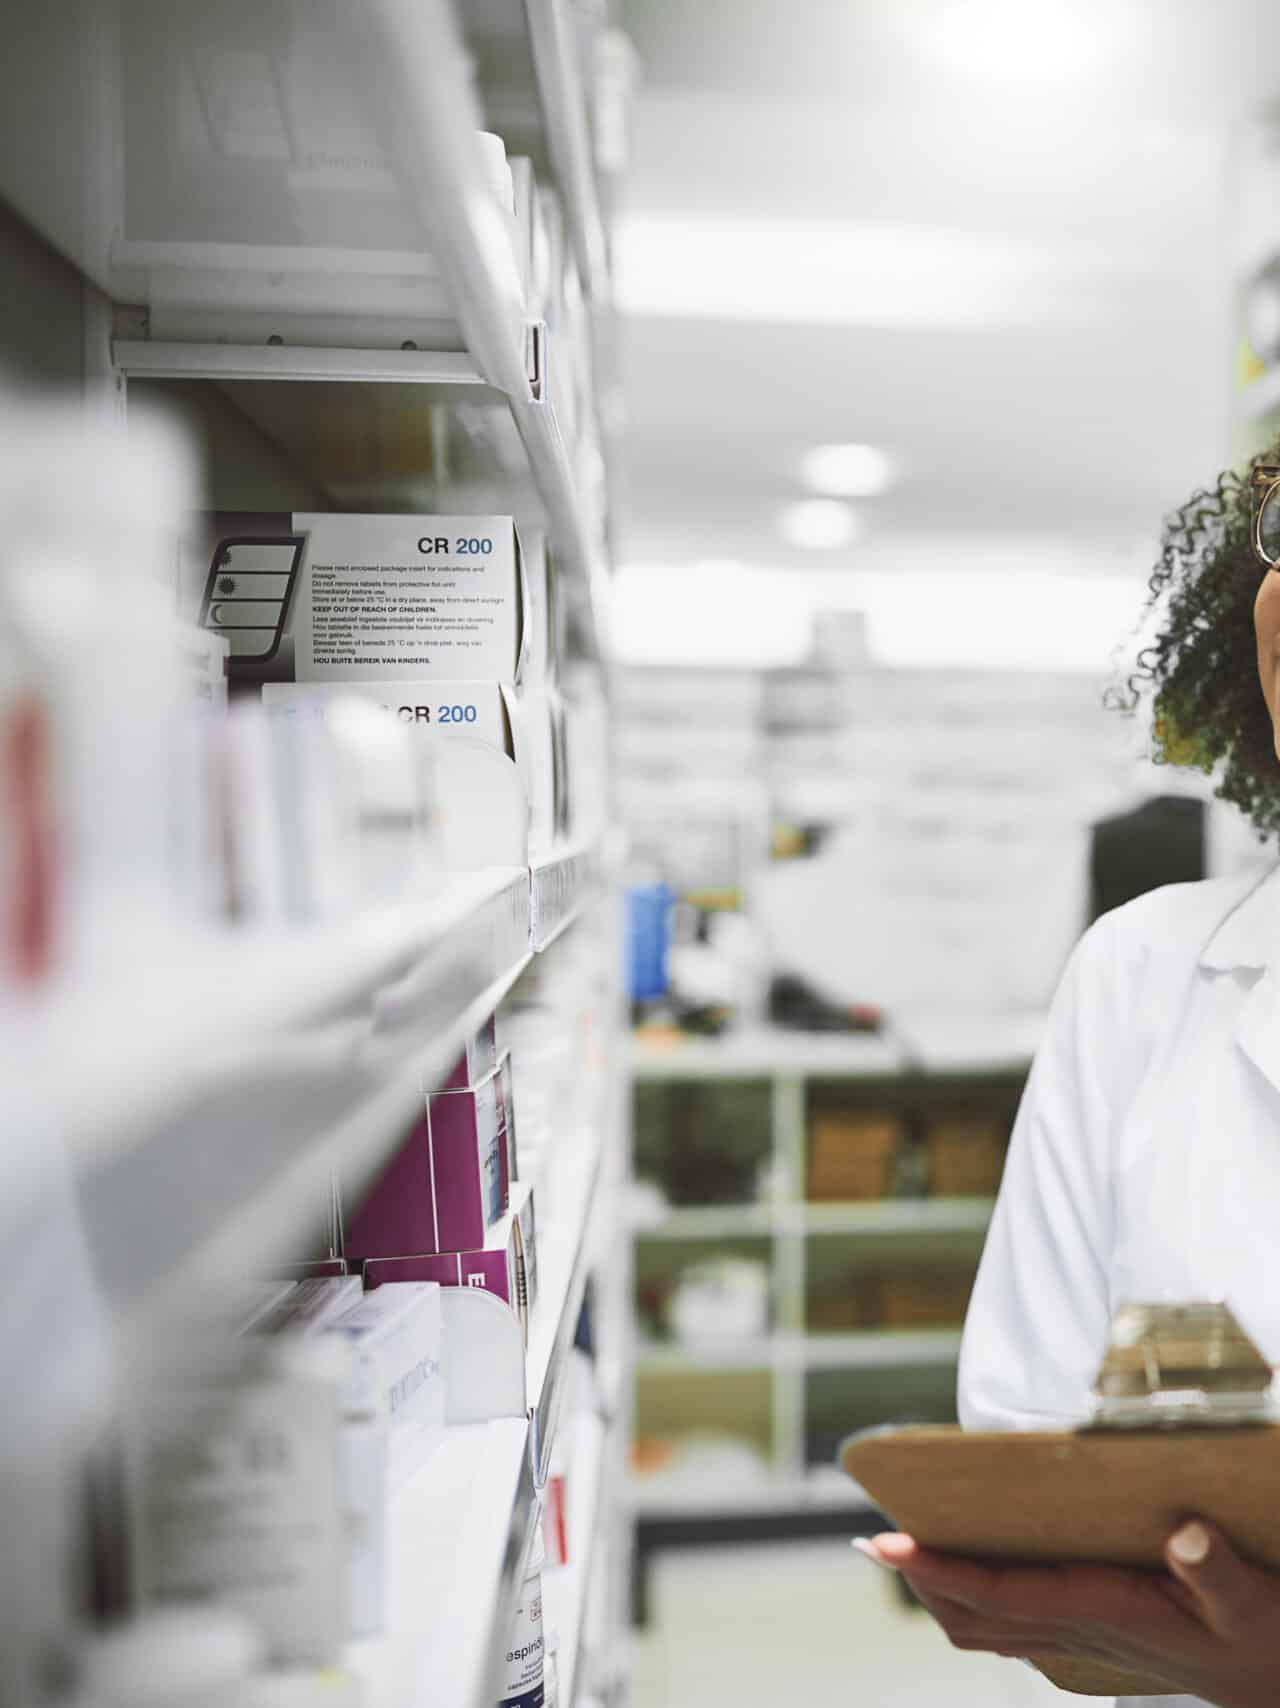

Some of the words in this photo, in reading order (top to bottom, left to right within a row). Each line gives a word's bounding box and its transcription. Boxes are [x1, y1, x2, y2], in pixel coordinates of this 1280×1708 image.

[417, 537, 449, 555] CR
[455, 537, 493, 555] 200
[438, 705, 477, 723] 200
